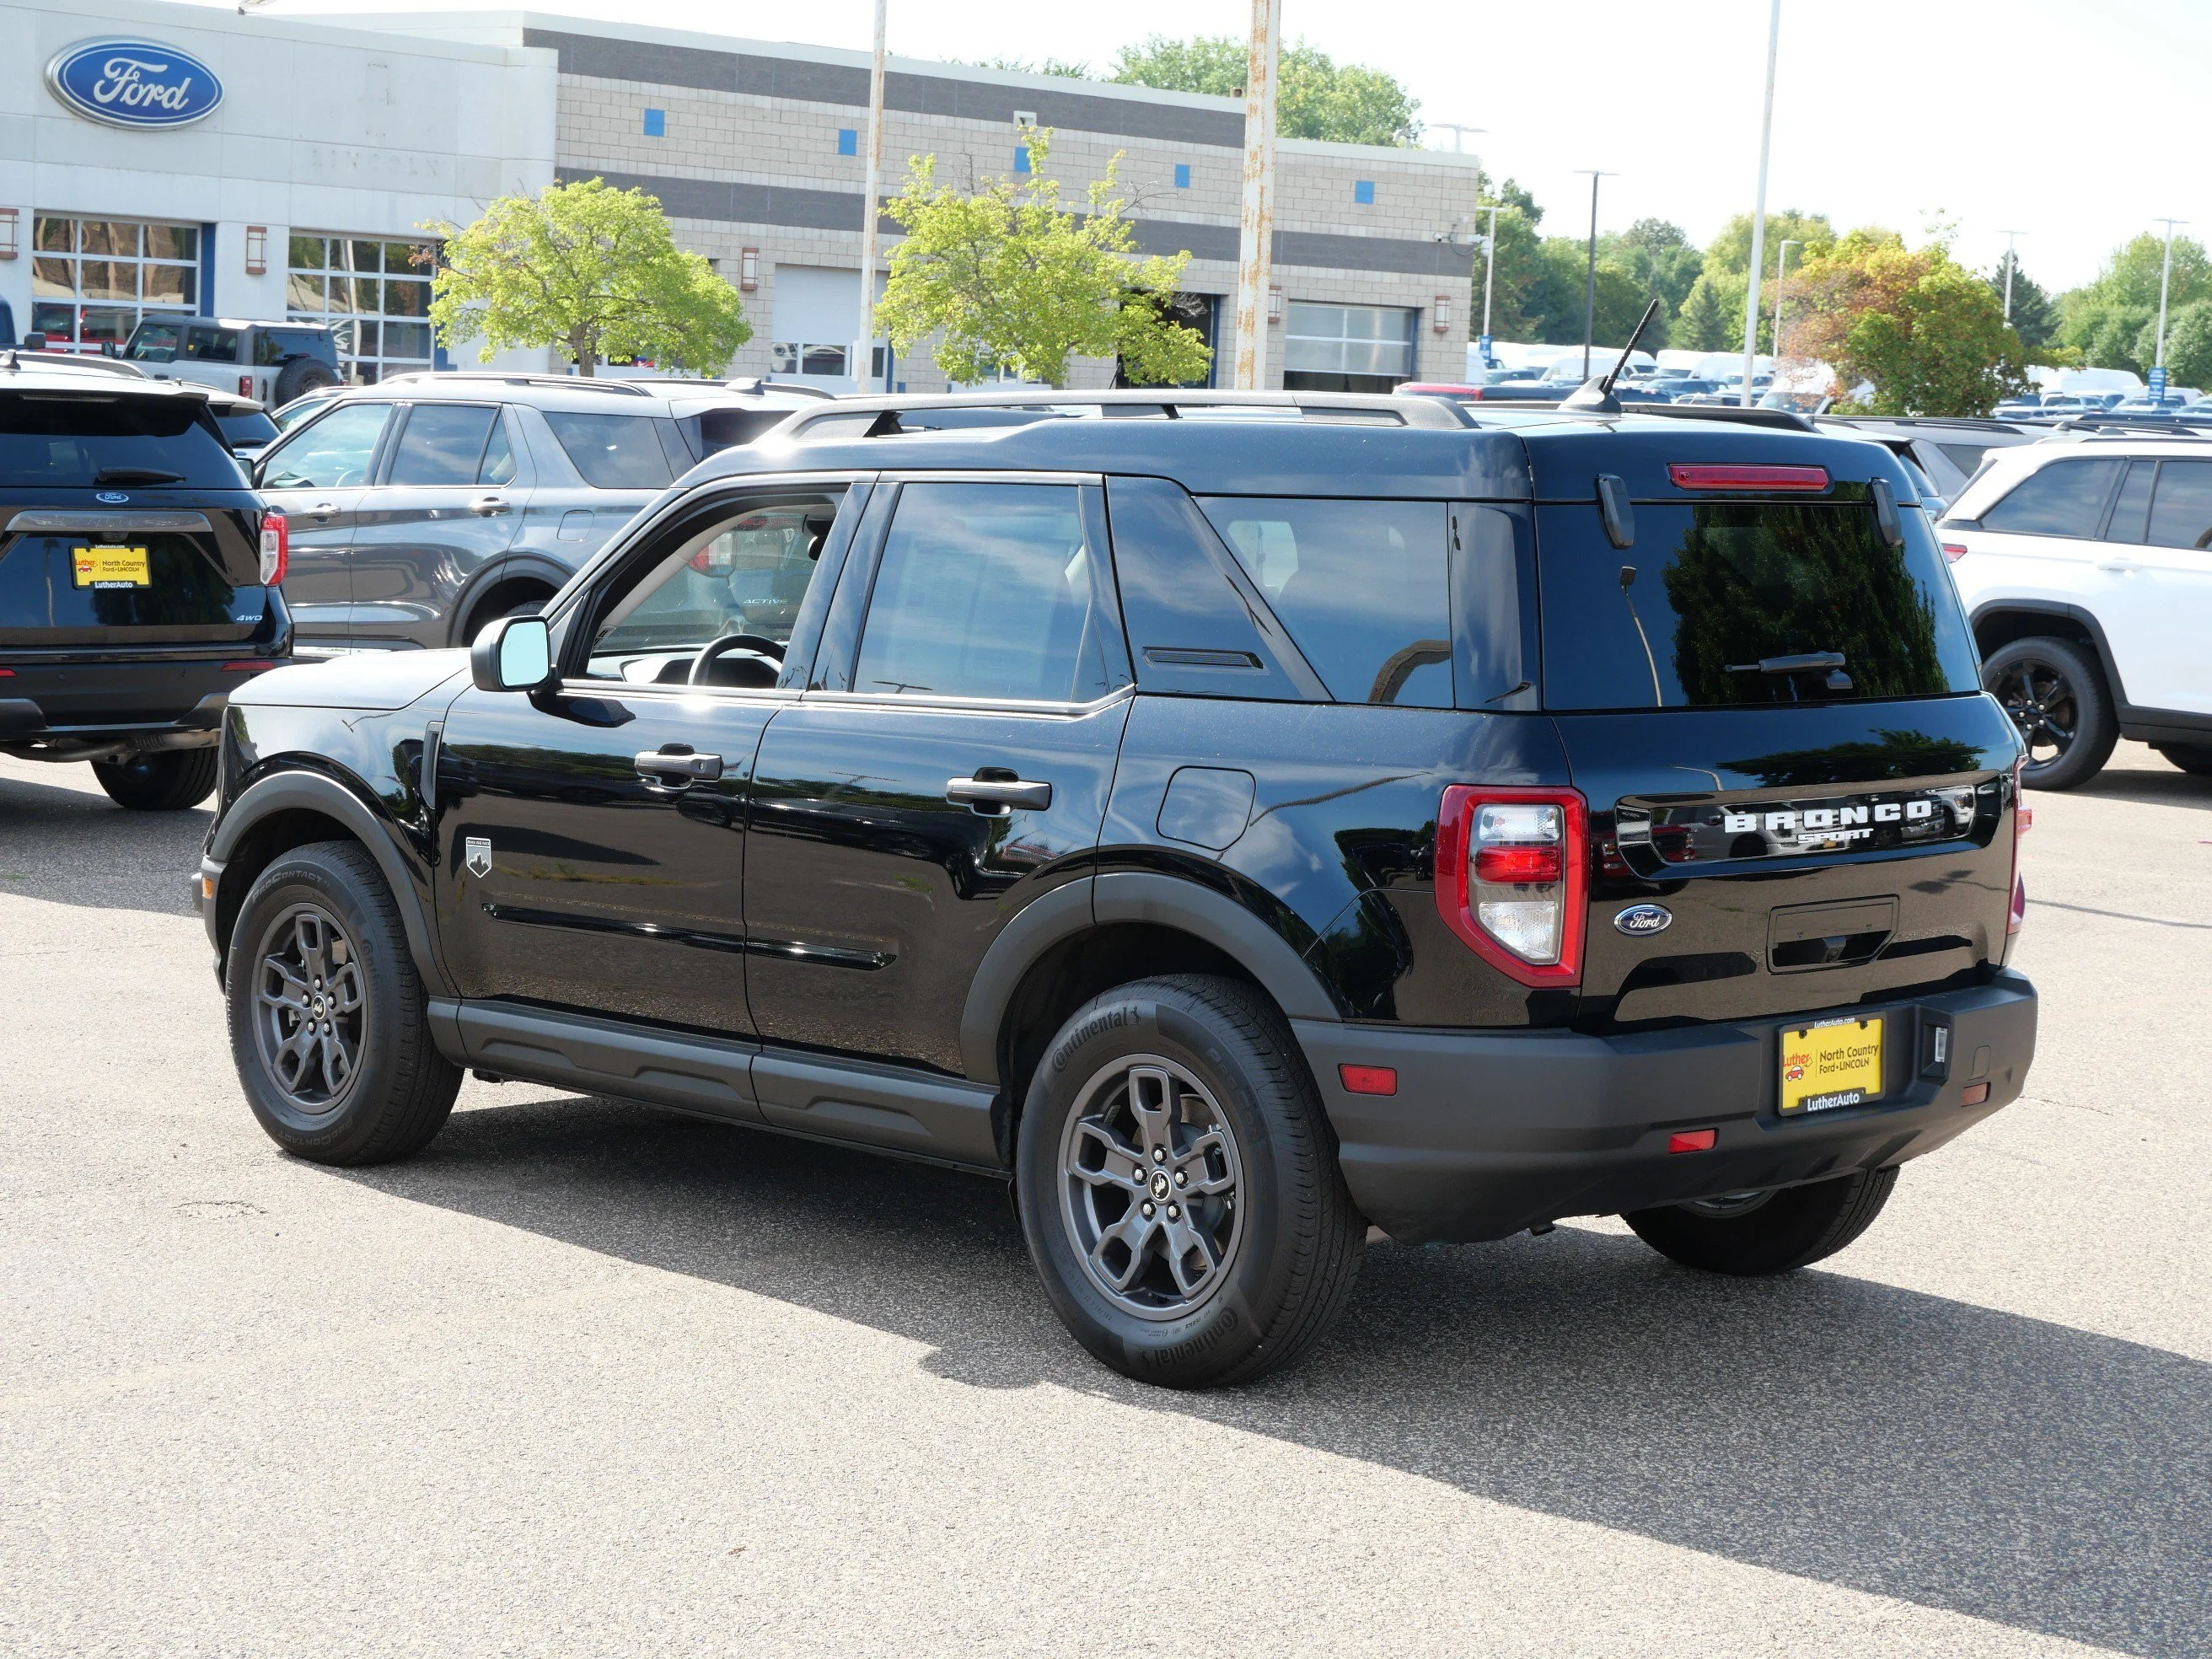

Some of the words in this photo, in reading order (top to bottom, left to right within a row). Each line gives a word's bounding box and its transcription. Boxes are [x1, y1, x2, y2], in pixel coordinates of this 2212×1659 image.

[93, 56, 192, 110] Ford
[1724, 800, 1932, 834] BRONCO
[1797, 828, 1874, 844] SPORT
[1629, 911, 1662, 928] Ford
[1814, 1017, 1855, 1028] LutherAuto.com
[1051, 1007, 1129, 1073] Continental
[1782, 1052, 1810, 1068] Luther
[1819, 1048, 1844, 1063] North
[1847, 1044, 1879, 1056] Country
[1807, 1092, 1860, 1112] LutherAuto
